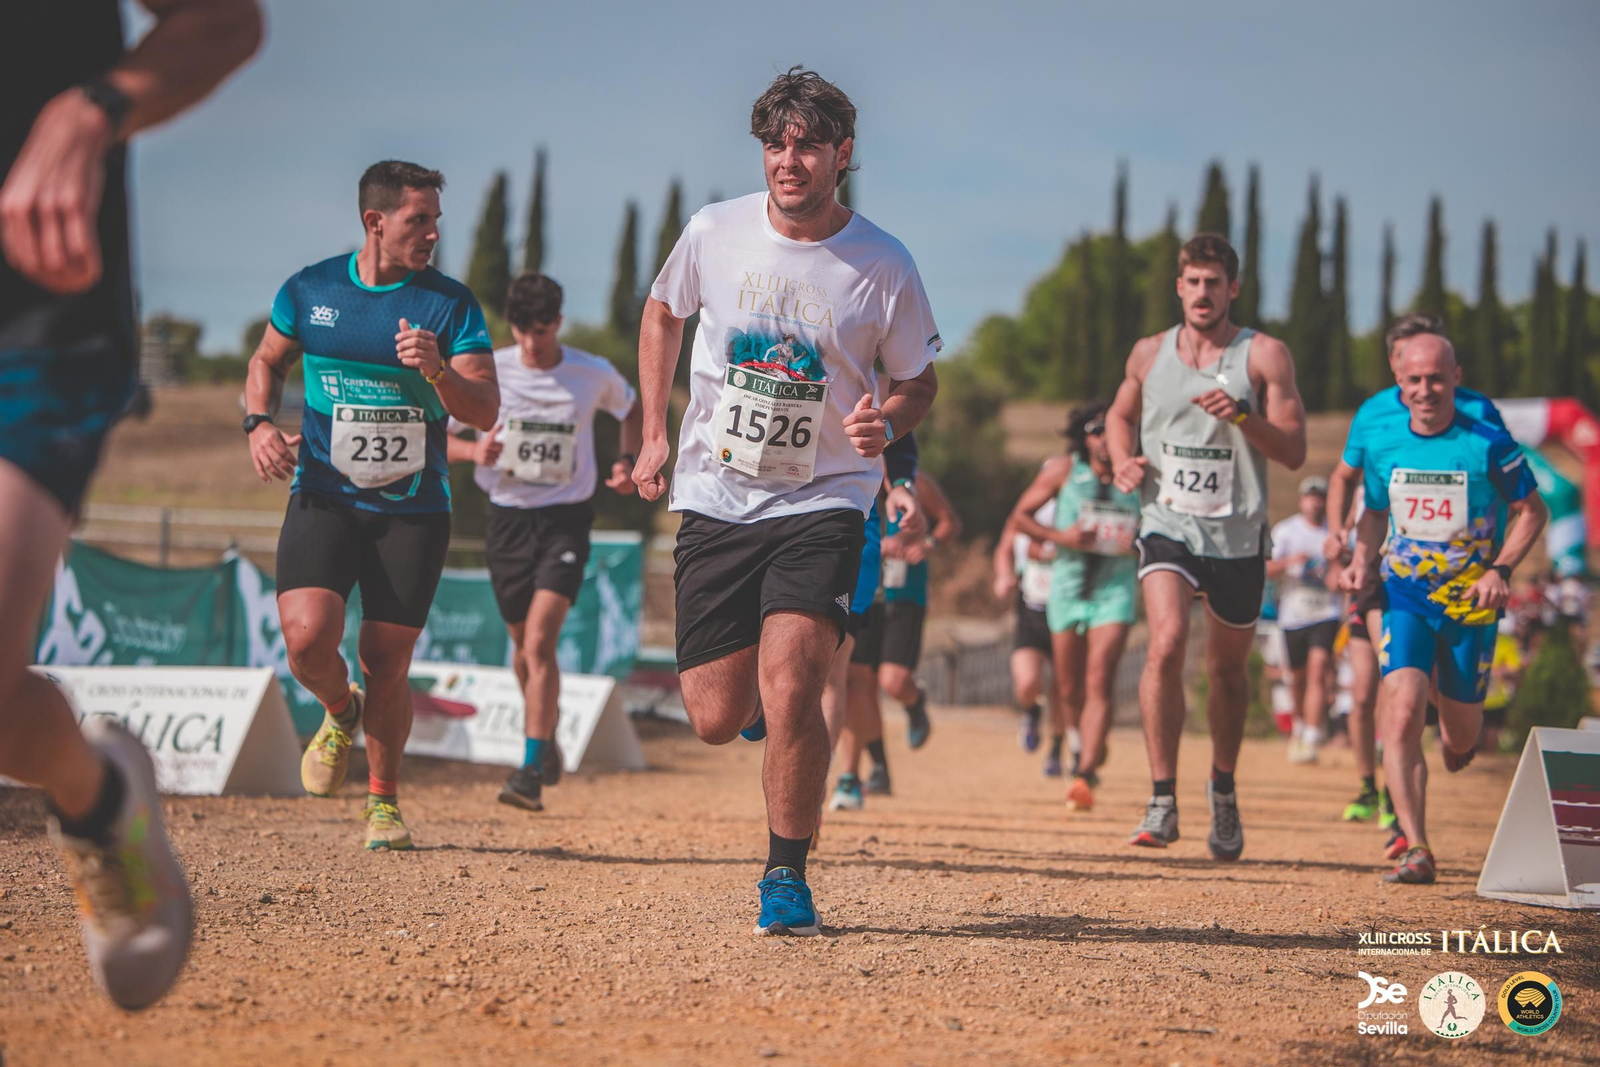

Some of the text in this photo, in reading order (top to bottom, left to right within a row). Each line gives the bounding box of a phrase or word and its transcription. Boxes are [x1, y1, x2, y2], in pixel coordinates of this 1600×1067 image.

[743, 271, 789, 293] XLIII
[788, 280, 828, 298] CROSS
[310, 305, 333, 320] 365
[737, 289, 834, 328] ITÁLICA
[343, 377, 400, 389] CRISTALERIA
[751, 377, 799, 396] ITÁLICA
[726, 404, 812, 448] 1526
[351, 435, 408, 462] 232
[517, 441, 562, 464] 694
[1173, 469, 1219, 493] 424
[1404, 498, 1453, 521] 754
[79, 701, 224, 754] LICA
